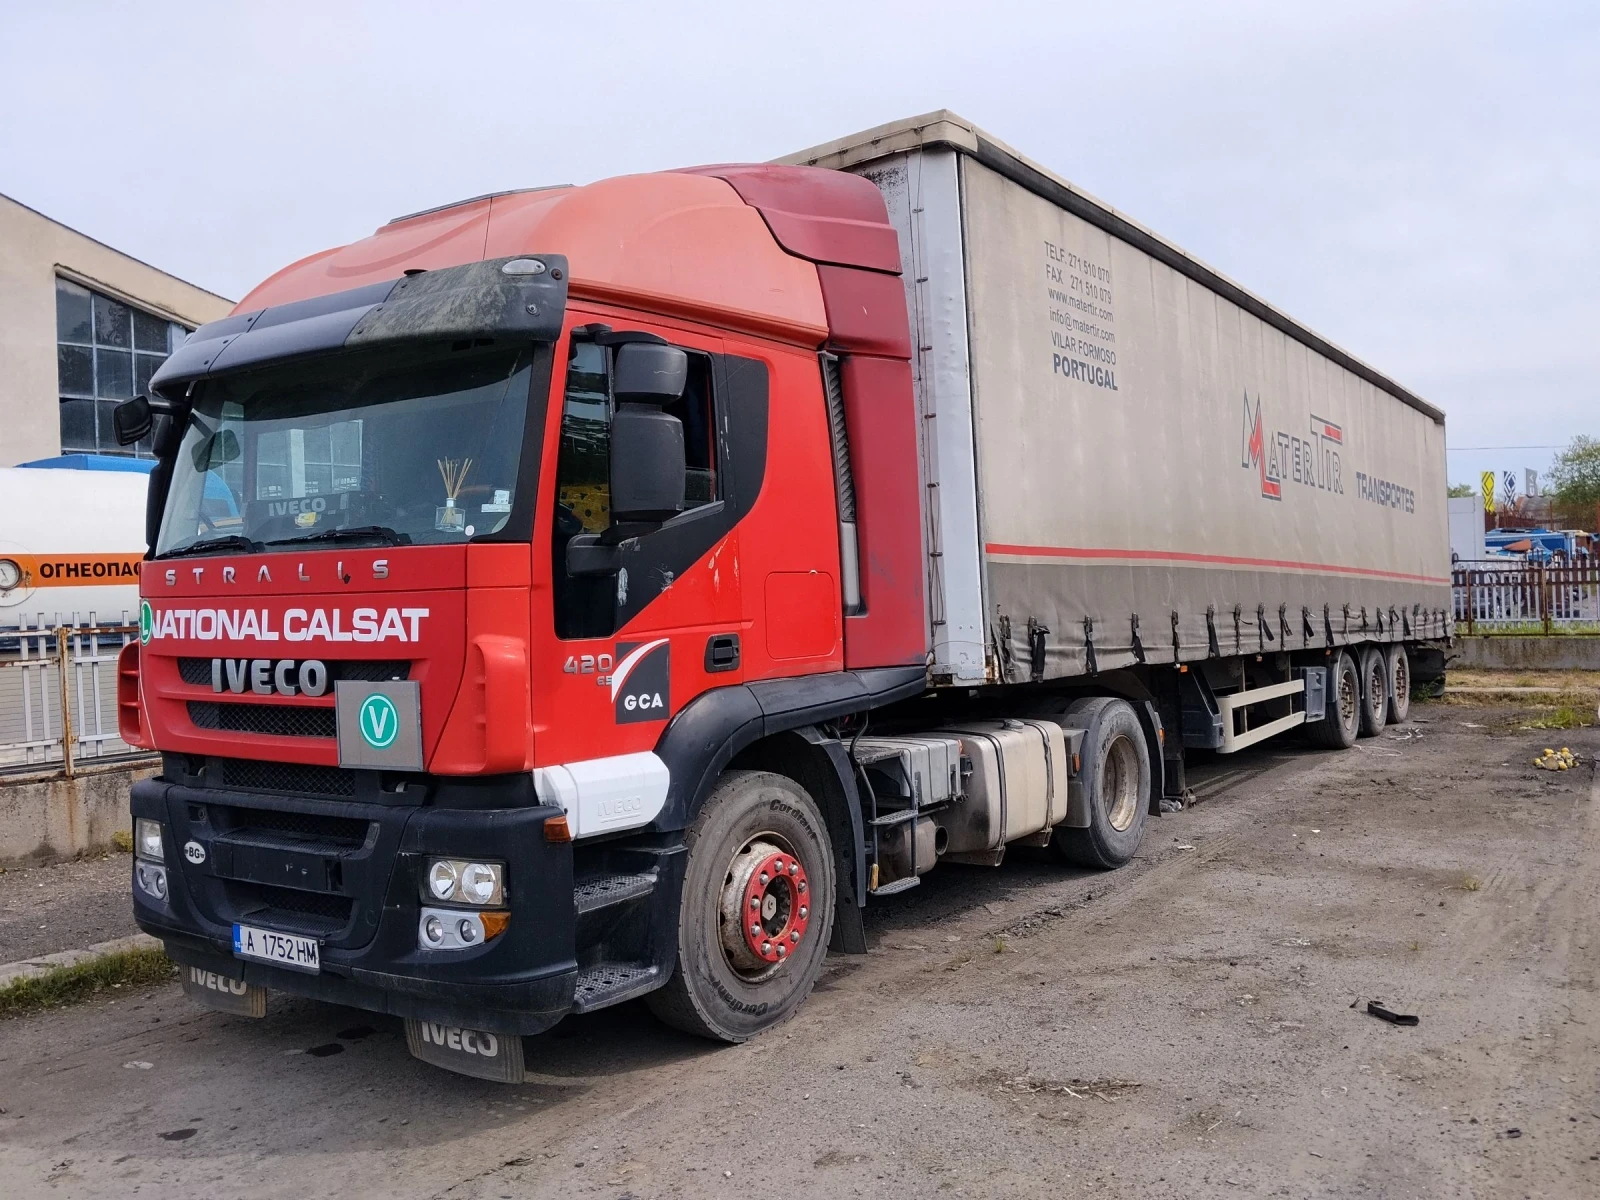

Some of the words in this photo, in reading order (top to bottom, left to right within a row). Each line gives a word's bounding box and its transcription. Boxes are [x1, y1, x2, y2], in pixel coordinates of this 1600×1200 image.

[1043, 240, 1067, 265] TELF.
[1068, 252, 1082, 272] 271
[1083, 259, 1097, 279] 510
[1097, 266, 1111, 285] 070
[1046, 263, 1064, 285] FAX
[1070, 274, 1084, 294] 271
[1085, 281, 1099, 299] 510
[1047, 287, 1115, 323] www.matertir.com
[1049, 306, 1116, 344] info@matertir.com
[1050, 329, 1077, 353] VILAR
[1078, 339, 1117, 366] FORMOSO
[1053, 352, 1119, 391] PORTUGAL
[268, 497, 327, 517] IVECO
[1355, 471, 1416, 514] TRANSPORTES
[283, 607, 430, 642] CALSAT
[211, 657, 328, 697] IVECO
[563, 653, 613, 675] 420
[624, 692, 664, 711] GCA
[368, 705, 389, 739] V
[769, 799, 819, 841] Cordiant
[188, 846, 201, 859] BG
[246, 931, 255, 952] A
[262, 933, 295, 960] 1752
[421, 1021, 498, 1057] IVECO
